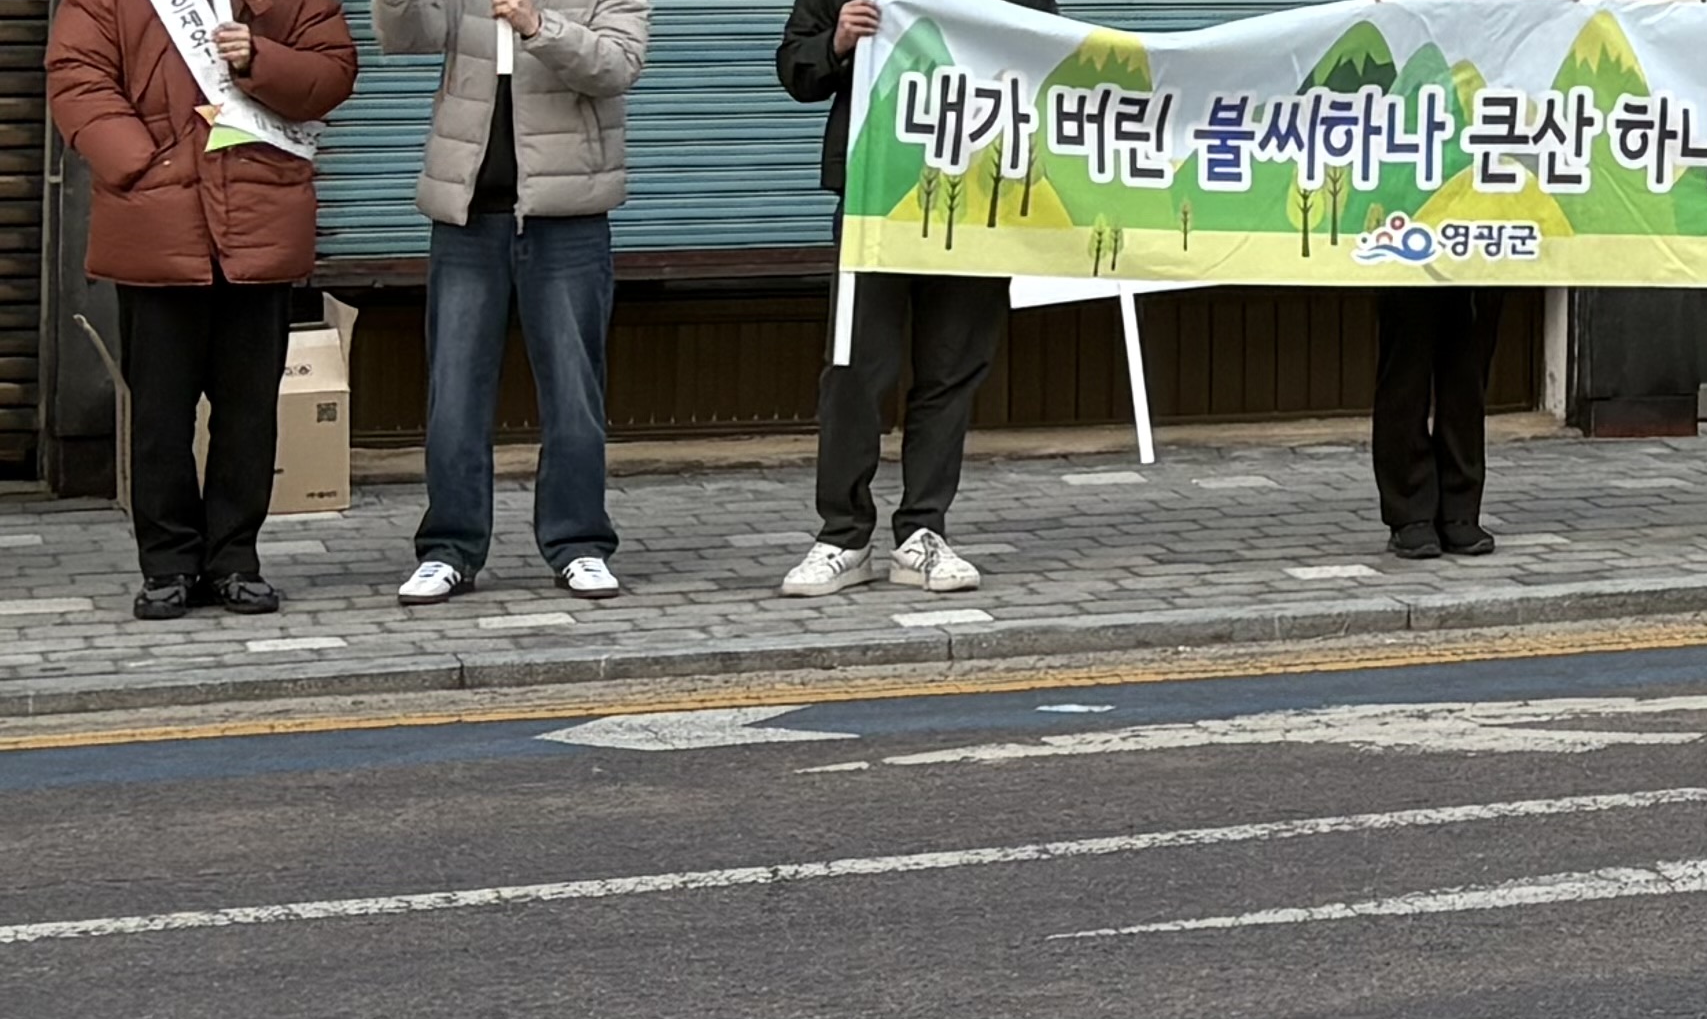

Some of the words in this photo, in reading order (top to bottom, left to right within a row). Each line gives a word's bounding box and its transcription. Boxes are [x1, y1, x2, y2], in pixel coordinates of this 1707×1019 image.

[903, 72, 1031, 170] 내가
[1055, 87, 1173, 180] 버린
[1194, 91, 1447, 183] 불씨하나
[1468, 94, 1595, 186] 큰산
[1440, 223, 1538, 258] 영광군
